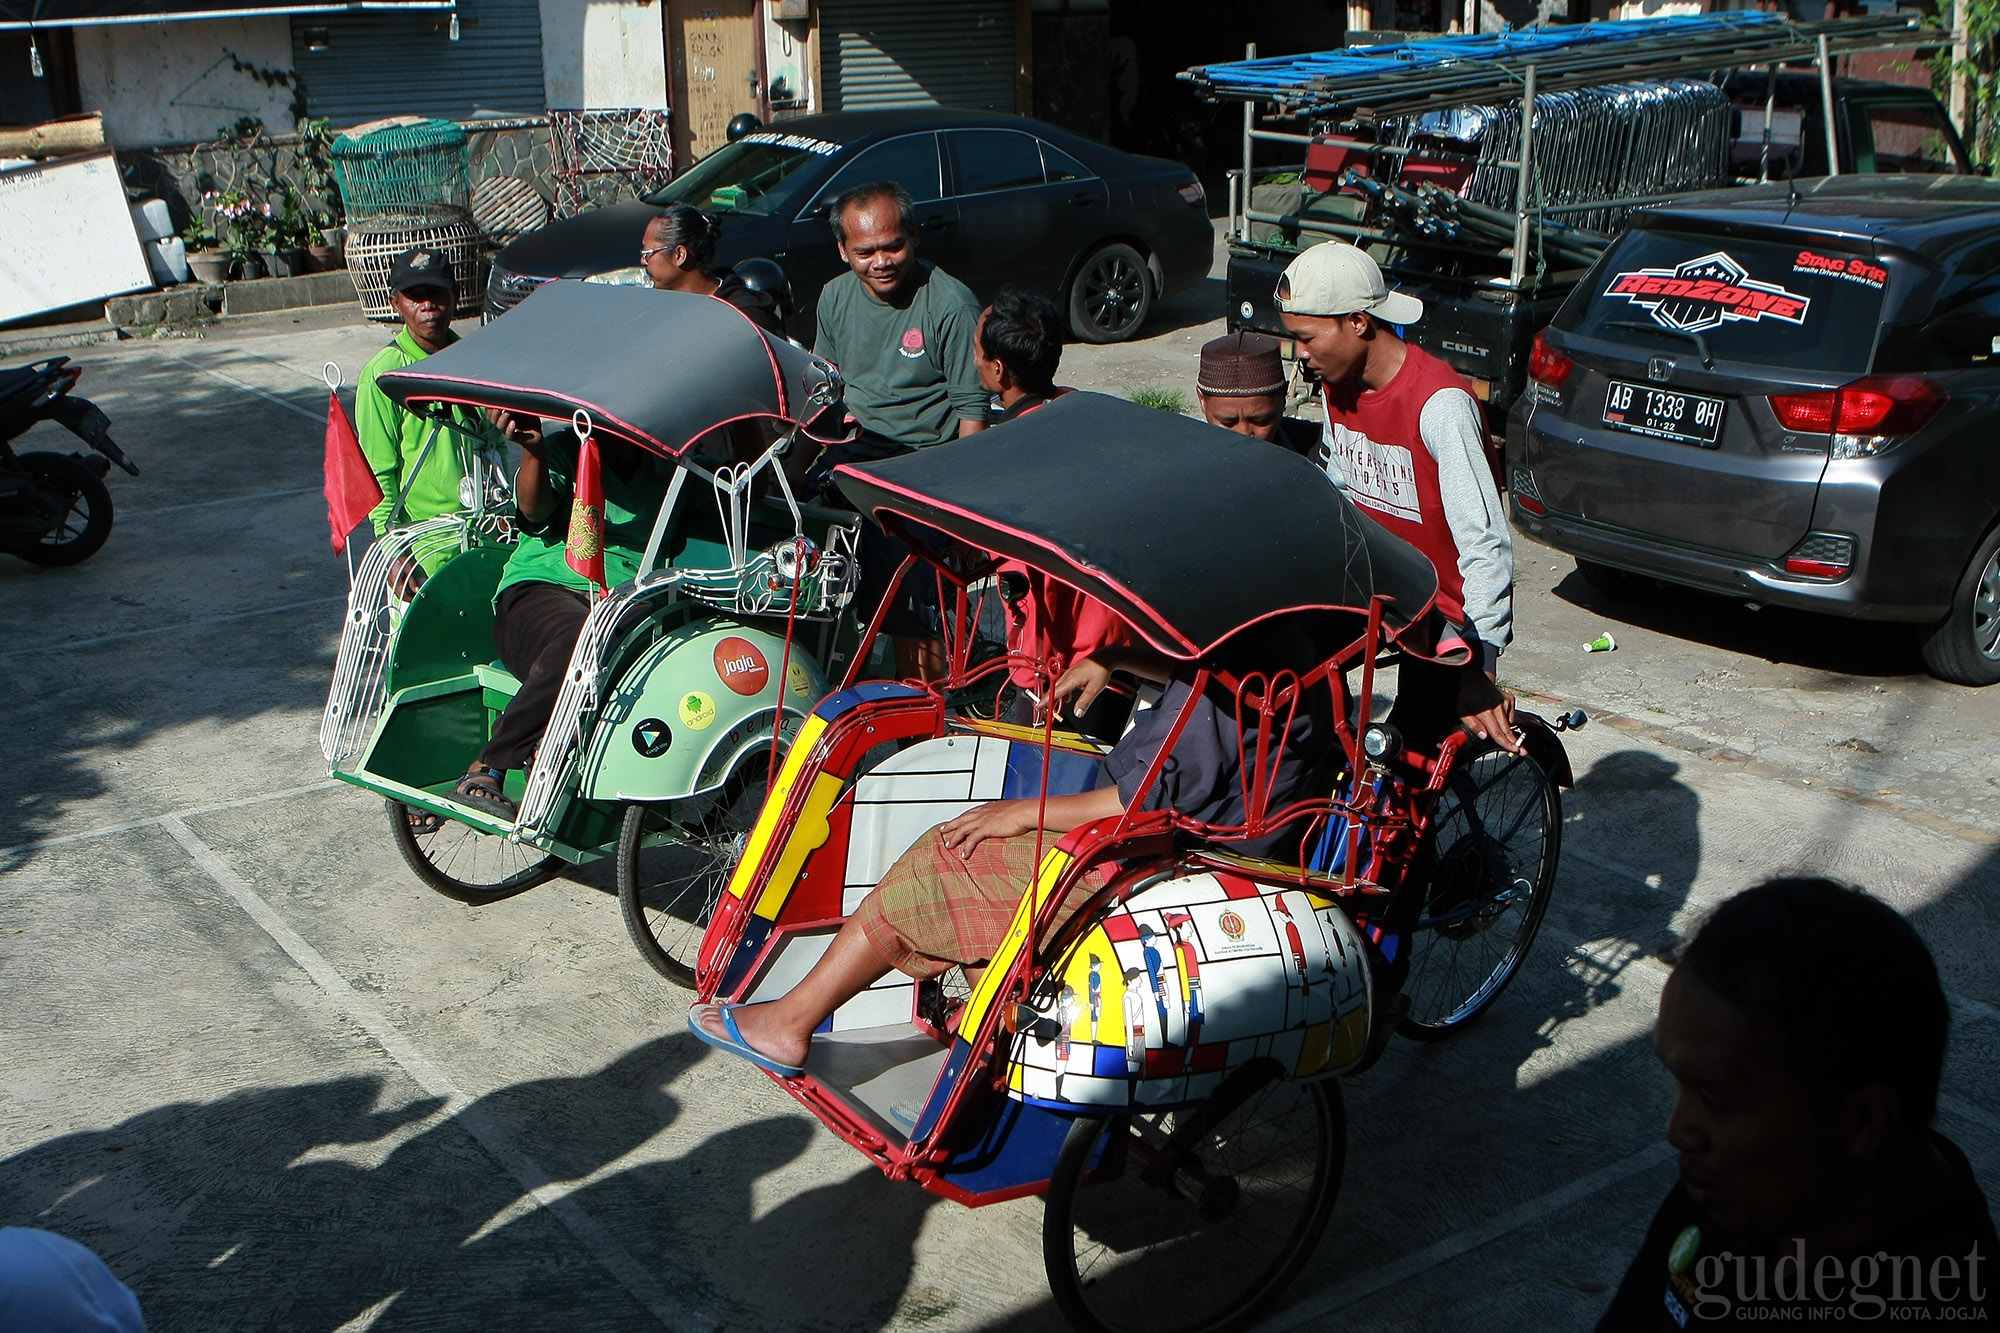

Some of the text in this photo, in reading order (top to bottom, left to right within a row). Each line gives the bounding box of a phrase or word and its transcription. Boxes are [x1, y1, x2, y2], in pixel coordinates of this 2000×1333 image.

[1441, 340, 1490, 357] COLT
[1610, 385, 1634, 410] AB
[1645, 391, 1686, 420] 1338
[1353, 468, 1400, 496] IDEAS
[686, 707, 715, 727] android
